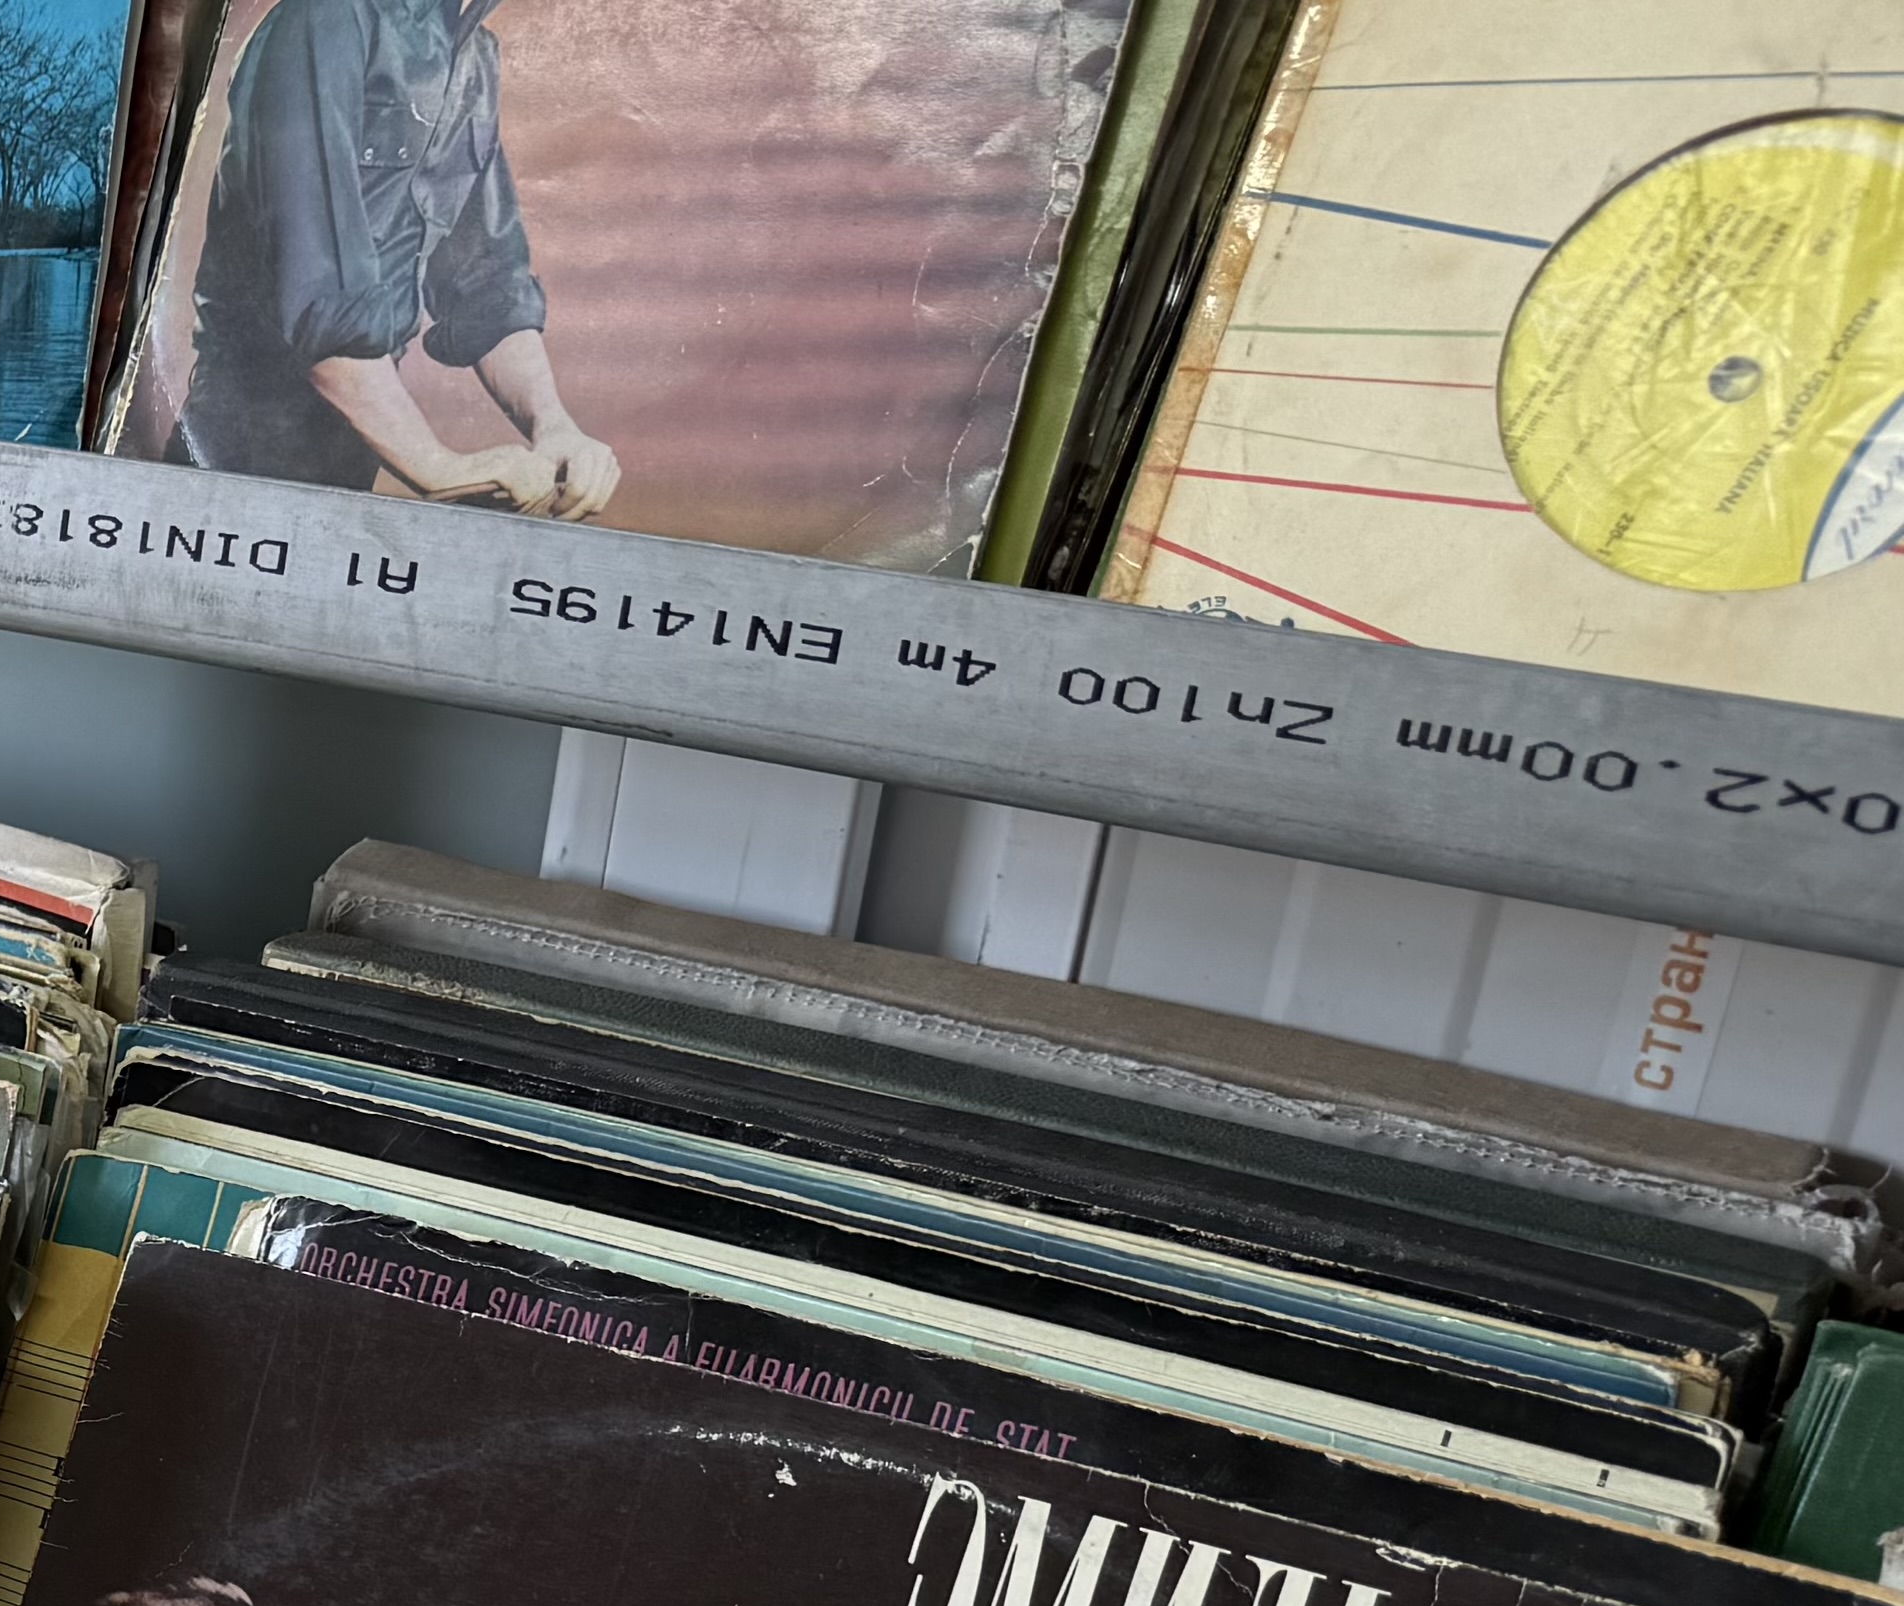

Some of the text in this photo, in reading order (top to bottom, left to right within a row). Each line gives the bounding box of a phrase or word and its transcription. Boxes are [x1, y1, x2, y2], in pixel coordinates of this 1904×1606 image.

[346, 551, 420, 596] A1
[508, 577, 845, 666] EN14195
[896, 638, 998, 688] 4m
[300, 1241, 471, 1316] ORCHESTRA
